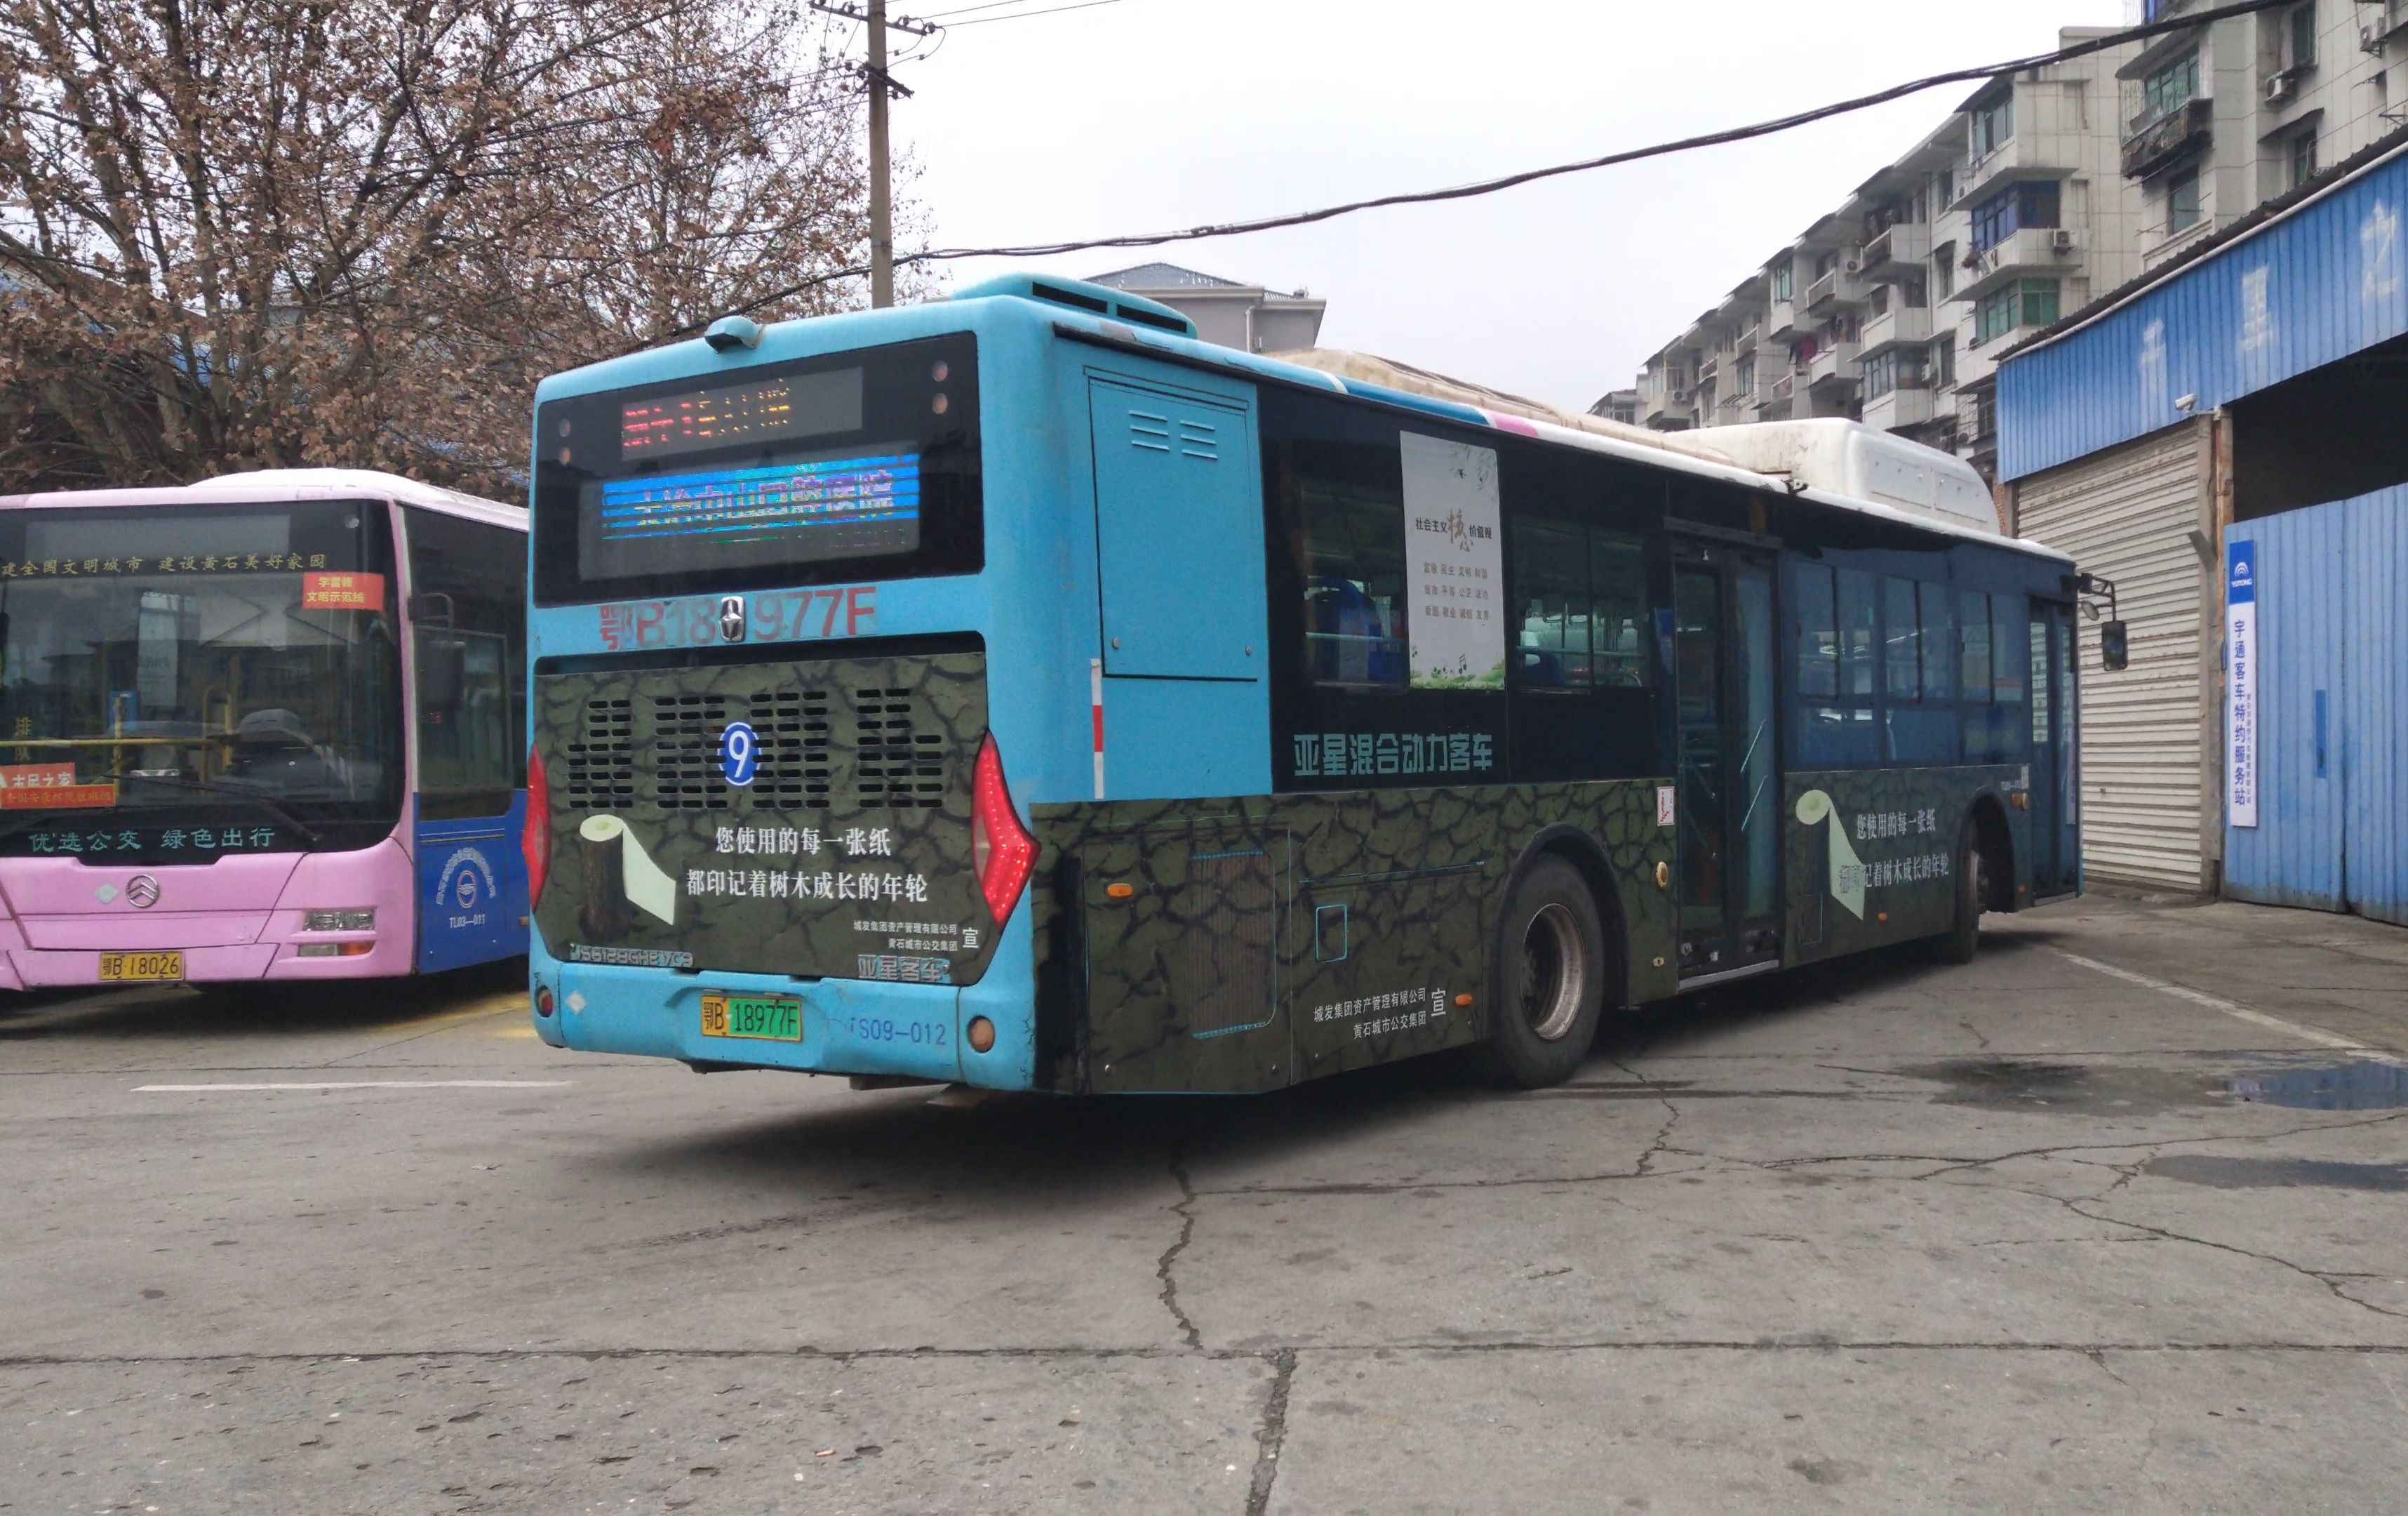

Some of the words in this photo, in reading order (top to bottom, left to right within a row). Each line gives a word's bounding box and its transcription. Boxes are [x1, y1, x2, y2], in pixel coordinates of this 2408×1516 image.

[159, 553, 326, 572] 建设黄石美好家园
[2231, 578, 2252, 587] YUTONG
[2234, 620, 2246, 806] 宇通客车特约服务站
[729, 731, 749, 778] 9
[1293, 733, 1492, 776] 亚星混合动力客车
[1857, 809, 1937, 840] 您使用的每一张纸
[28, 830, 142, 852] 优选公交
[160, 827, 276, 849] 绿色出行
[716, 827, 891, 856] 您使用的每一张纸
[686, 869, 928, 903] 都印记着树木成长的年轮
[853, 920, 958, 936] 城发集团资产管理有限公司
[963, 927, 979, 948] 宣
[888, 938, 958, 952] 黄石城市公交集团
[858, 955, 944, 982] 亚星客车
[1313, 988, 1426, 1023] 城发集团资产管理有限公司
[1431, 988, 1446, 1017] 宣
[1353, 1011, 1426, 1039] 黄石城市公交集团
